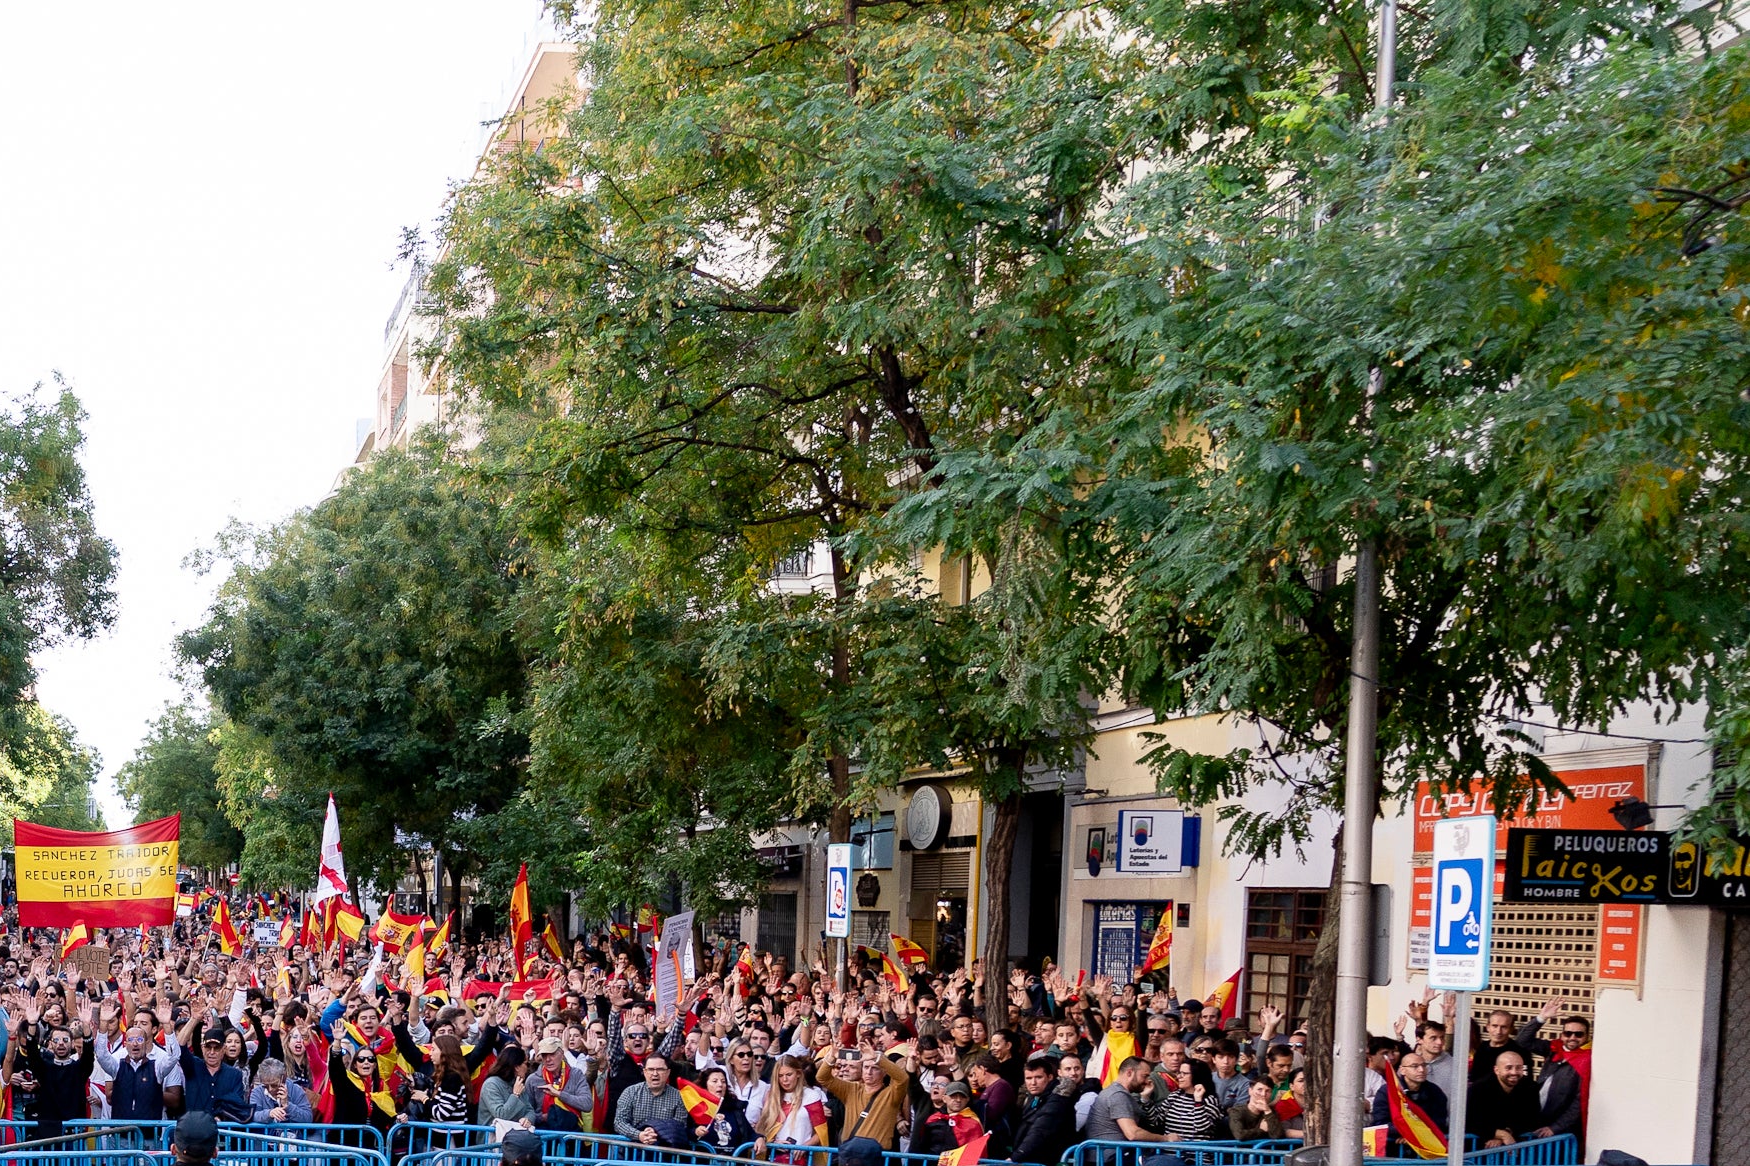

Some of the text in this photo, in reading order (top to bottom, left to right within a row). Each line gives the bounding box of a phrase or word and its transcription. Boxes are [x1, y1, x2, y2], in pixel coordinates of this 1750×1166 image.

[1554, 836, 1658, 853] PELUQUEROS
[33, 846, 170, 861] SANCHEZ TRAIDOR
[108, 866, 151, 879] JUDAS
[159, 865, 175, 876] SE
[63, 882, 142, 898] AHORCO
[1523, 888, 1581, 898] HOMBRE
[1438, 867, 1473, 947] P
